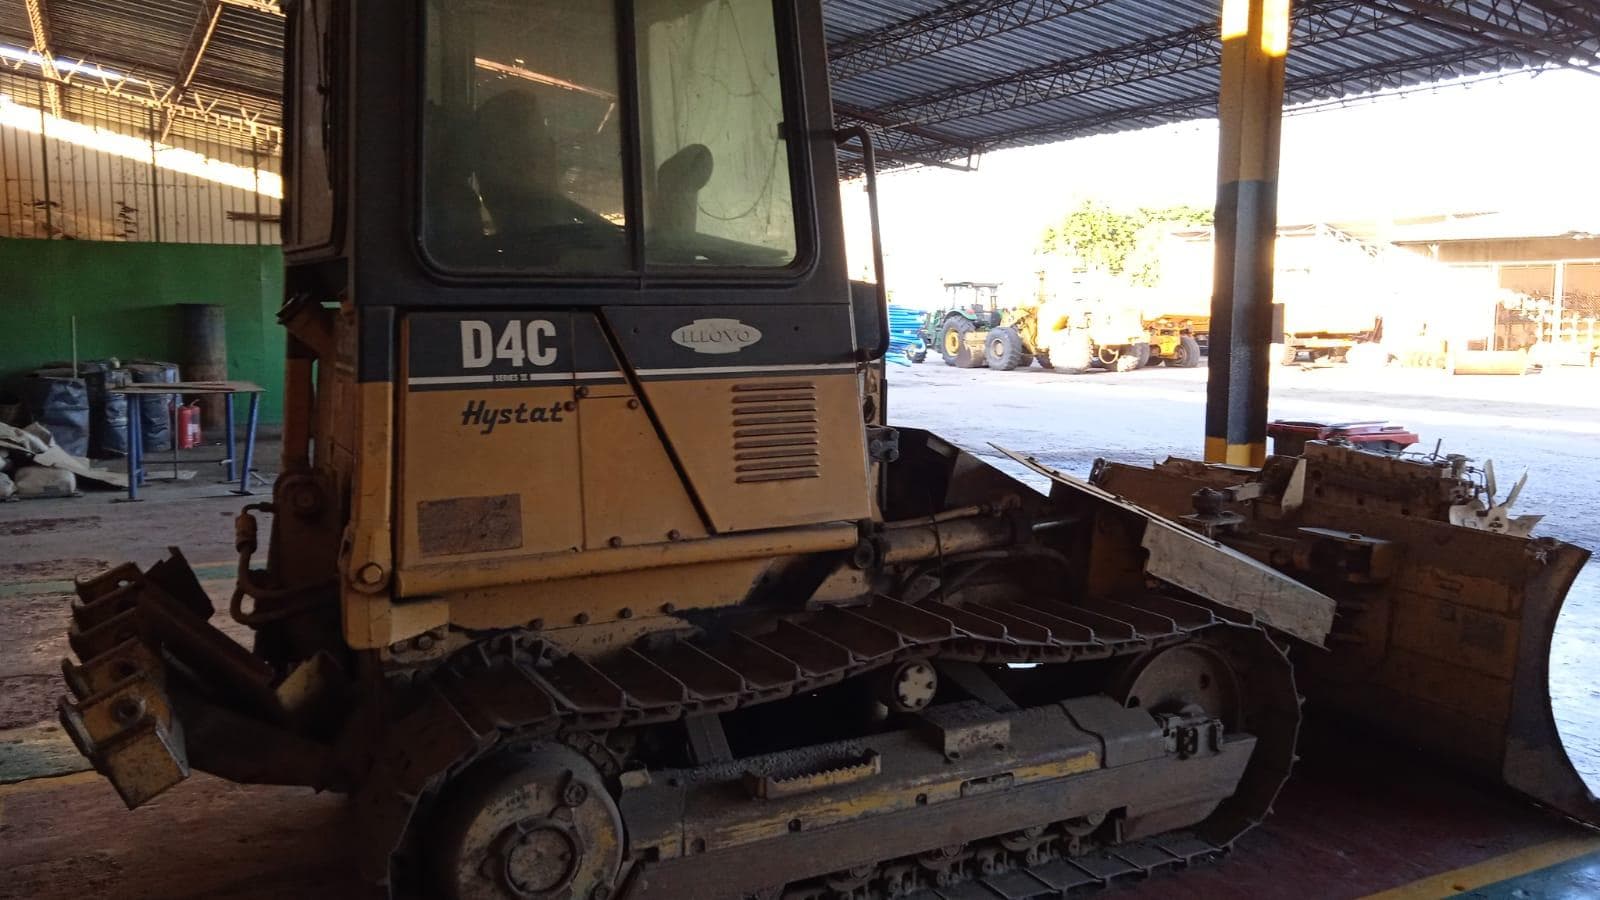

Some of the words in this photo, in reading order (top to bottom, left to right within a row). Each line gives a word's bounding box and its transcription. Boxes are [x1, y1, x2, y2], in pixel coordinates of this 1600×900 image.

[461, 320, 558, 368] D4C
[681, 328, 750, 343] ILLOVO
[461, 400, 563, 435] Hystat
